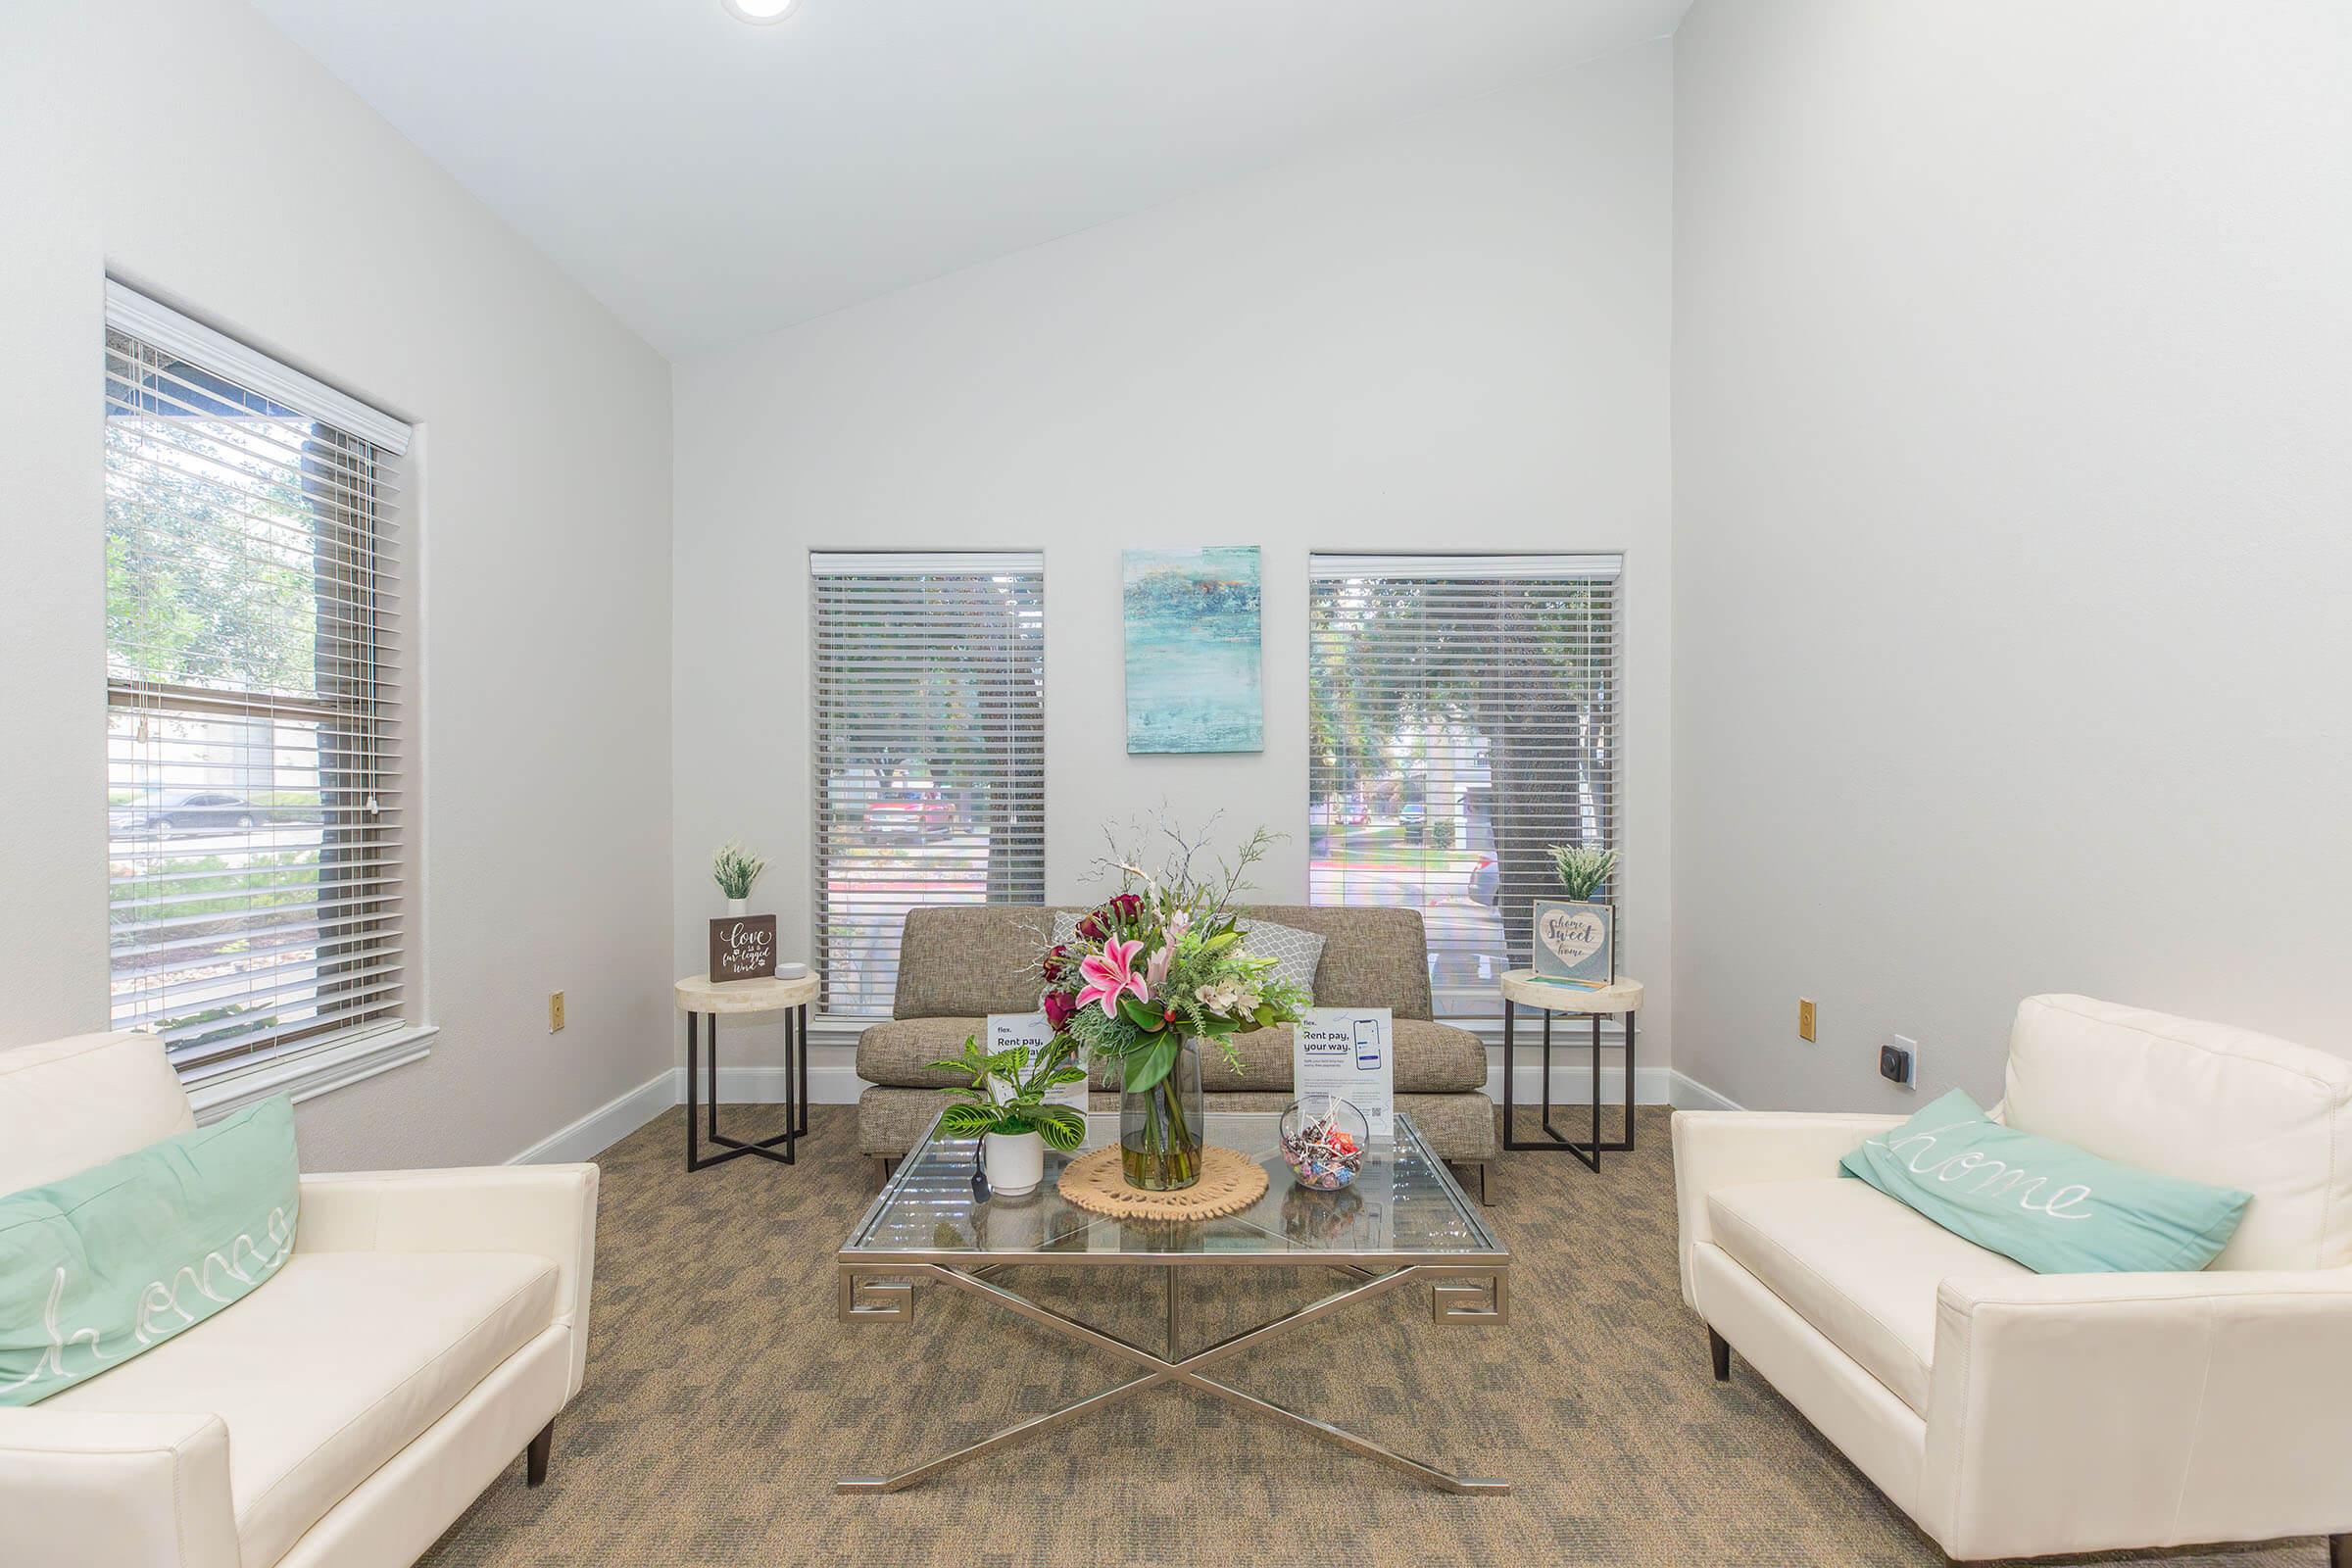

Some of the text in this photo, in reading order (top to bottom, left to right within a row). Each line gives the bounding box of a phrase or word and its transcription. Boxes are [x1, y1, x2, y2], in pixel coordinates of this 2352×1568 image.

[1558, 943, 1584, 956] home
[1303, 1031, 1327, 1040] Rent
[998, 1038, 1022, 1047] Rent
[1303, 1043, 1327, 1053] your
